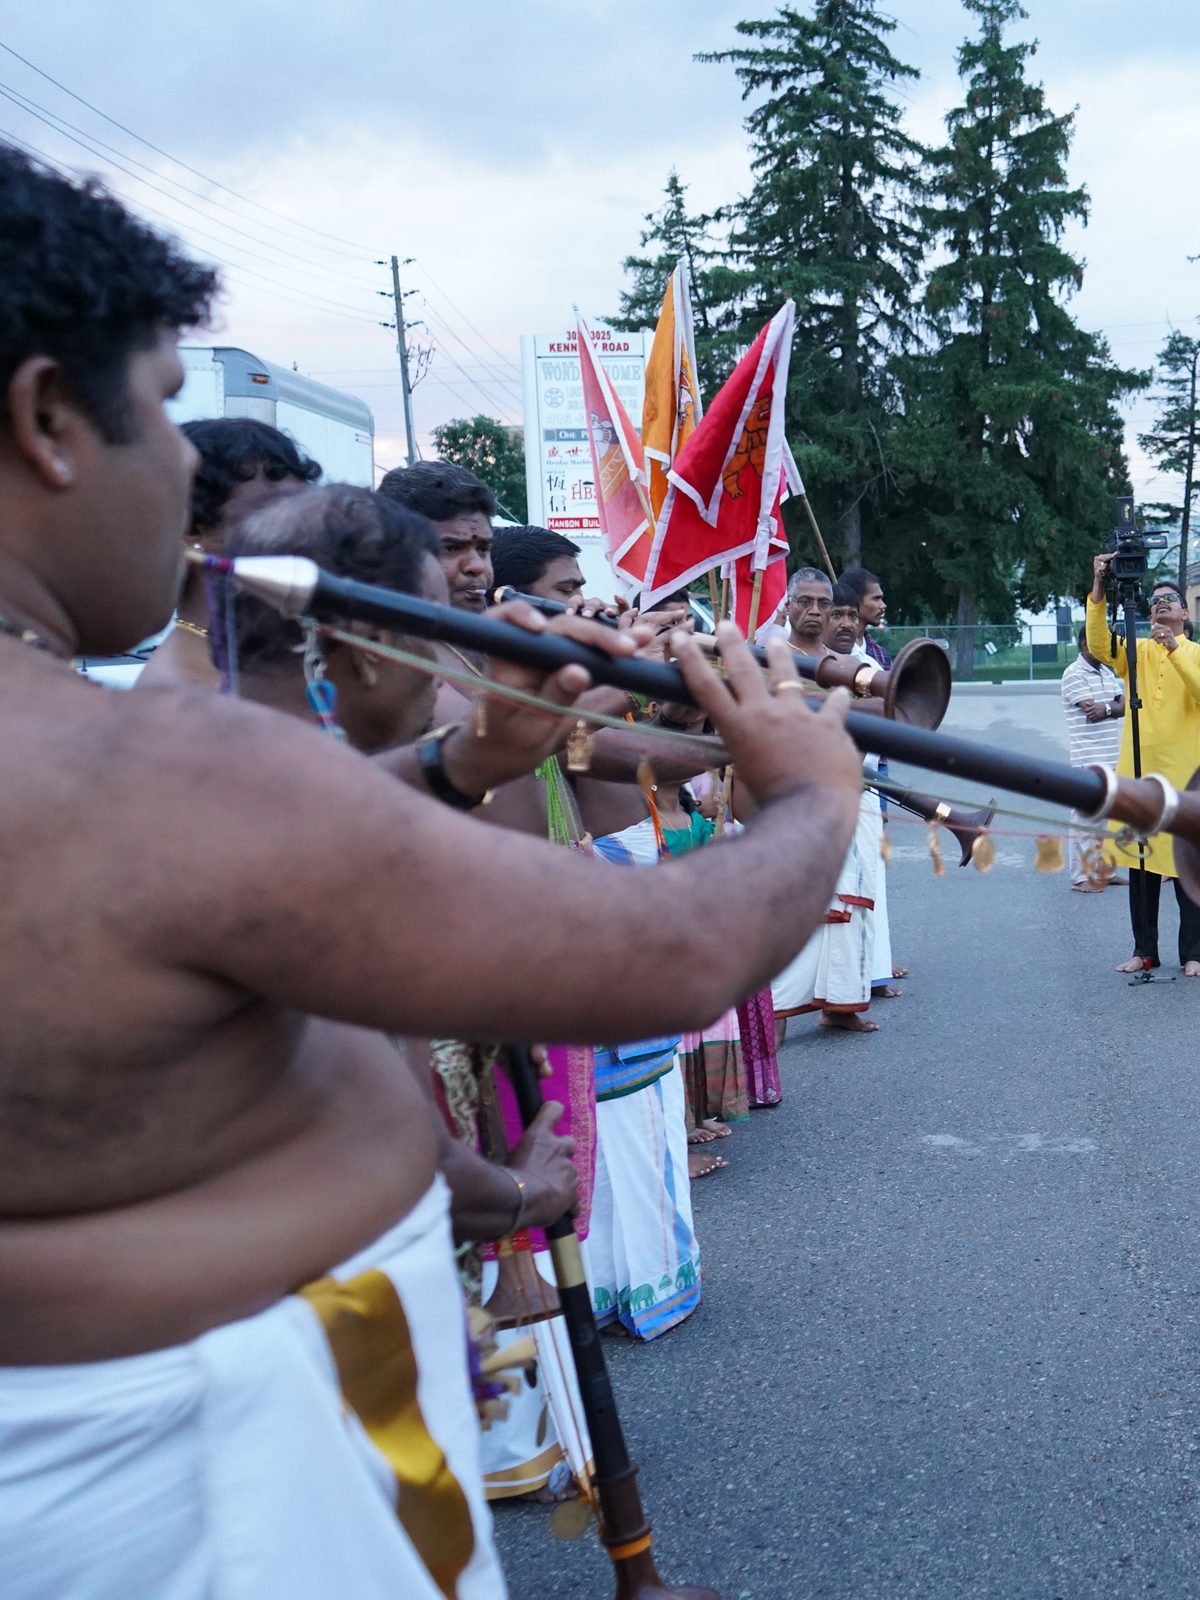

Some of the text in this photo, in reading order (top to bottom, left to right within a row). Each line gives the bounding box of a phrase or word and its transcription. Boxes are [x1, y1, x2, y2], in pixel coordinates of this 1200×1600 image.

[549, 343, 629, 352] KENNY ROAD
[543, 365, 580, 381] WOND
[572, 480, 597, 500] HB
[582, 519, 600, 528] BUIL
